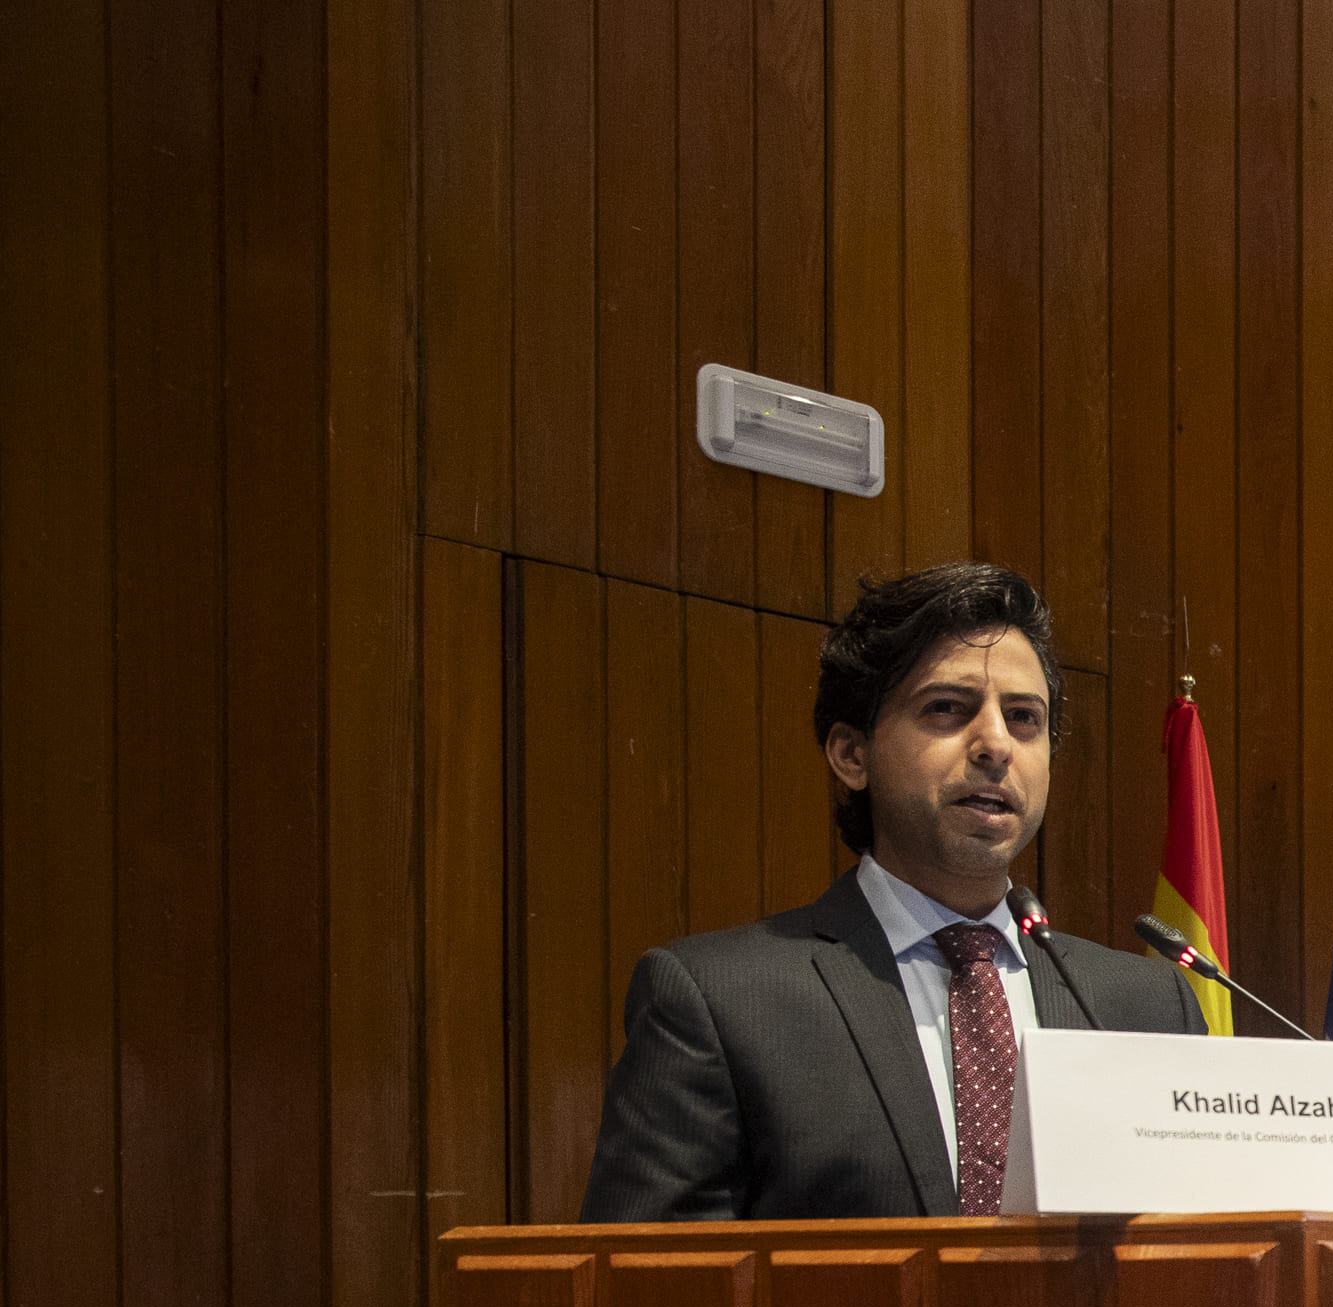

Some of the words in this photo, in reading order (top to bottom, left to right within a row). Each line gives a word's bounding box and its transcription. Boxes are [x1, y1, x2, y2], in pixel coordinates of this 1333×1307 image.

[1171, 1089, 1261, 1116] Khalid
[1135, 1128, 1222, 1140] Vicepresidente
[1225, 1131, 1239, 1141] de
[1241, 1132, 1252, 1141] la
[1254, 1132, 1307, 1143] Comisión
[1310, 1134, 1327, 1144] del
